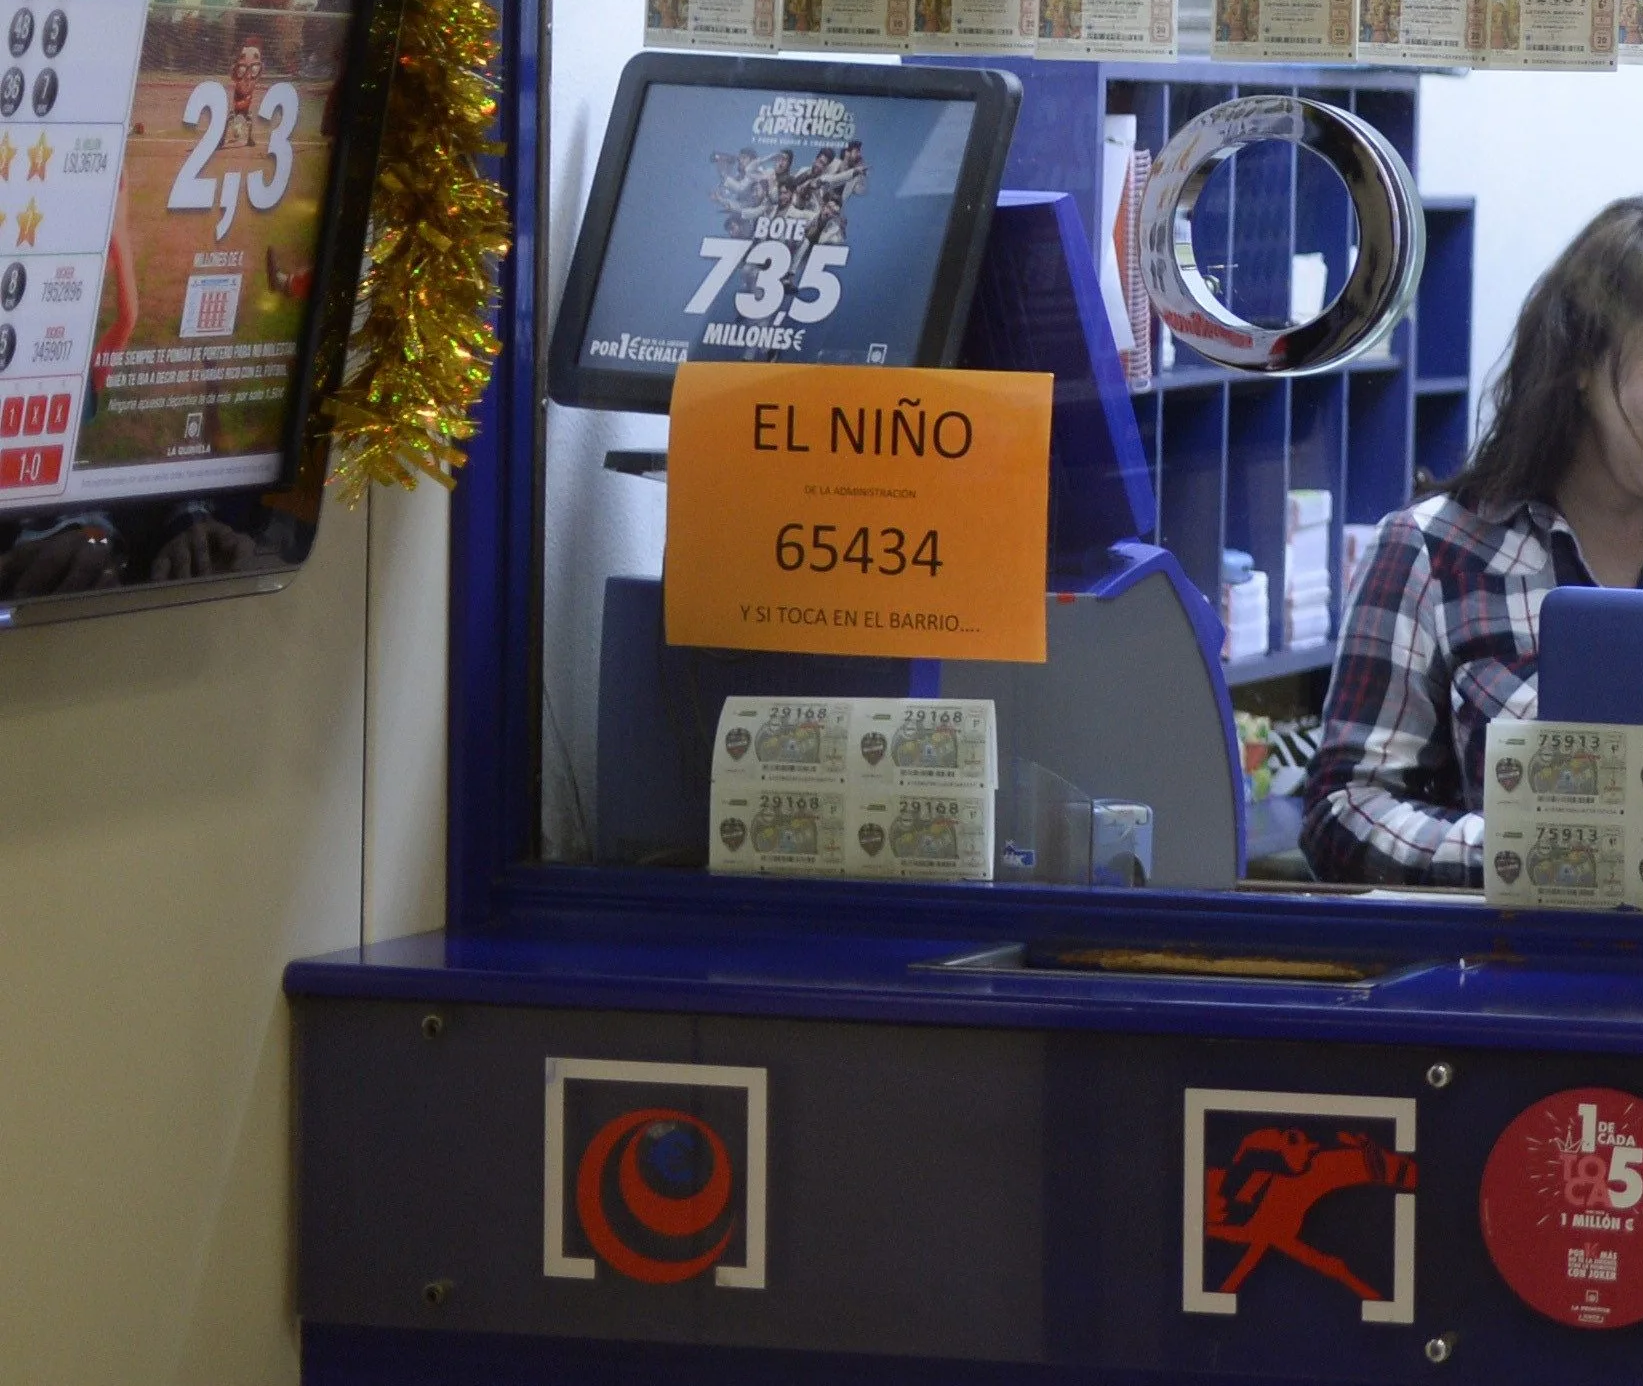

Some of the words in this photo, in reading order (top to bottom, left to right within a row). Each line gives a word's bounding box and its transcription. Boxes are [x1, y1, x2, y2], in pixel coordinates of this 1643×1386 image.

[773, 97, 845, 122] DESTINO
[752, 116, 856, 140] CAPRICHOSO
[168, 80, 300, 241] 2,3
[755, 217, 806, 242] BOTE
[684, 237, 849, 325] 73,5
[753, 403, 809, 453] EL
[830, 398, 973, 459] NIÑO
[20, 453, 41, 481] 1-0
[804, 484, 817, 495] DE
[819, 485, 831, 496] LA
[834, 485, 917, 499] ADMINISTRACIÓN
[775, 522, 944, 577] 65434
[740, 605, 752, 623] Y
[757, 605, 771, 623] SI
[778, 606, 827, 626] TOCA
[834, 609, 858, 628] EN
[864, 611, 883, 628] EL
[904, 710, 963, 724] 29168
[1539, 732, 1600, 749] 75913
[1578, 1103, 1597, 1153] 1
[1597, 1134, 1636, 1147] CADA
[1598, 1122, 1615, 1134] DE
[1607, 1147, 1643, 1208] 5
[1572, 1214, 1621, 1230] MILLÓN
